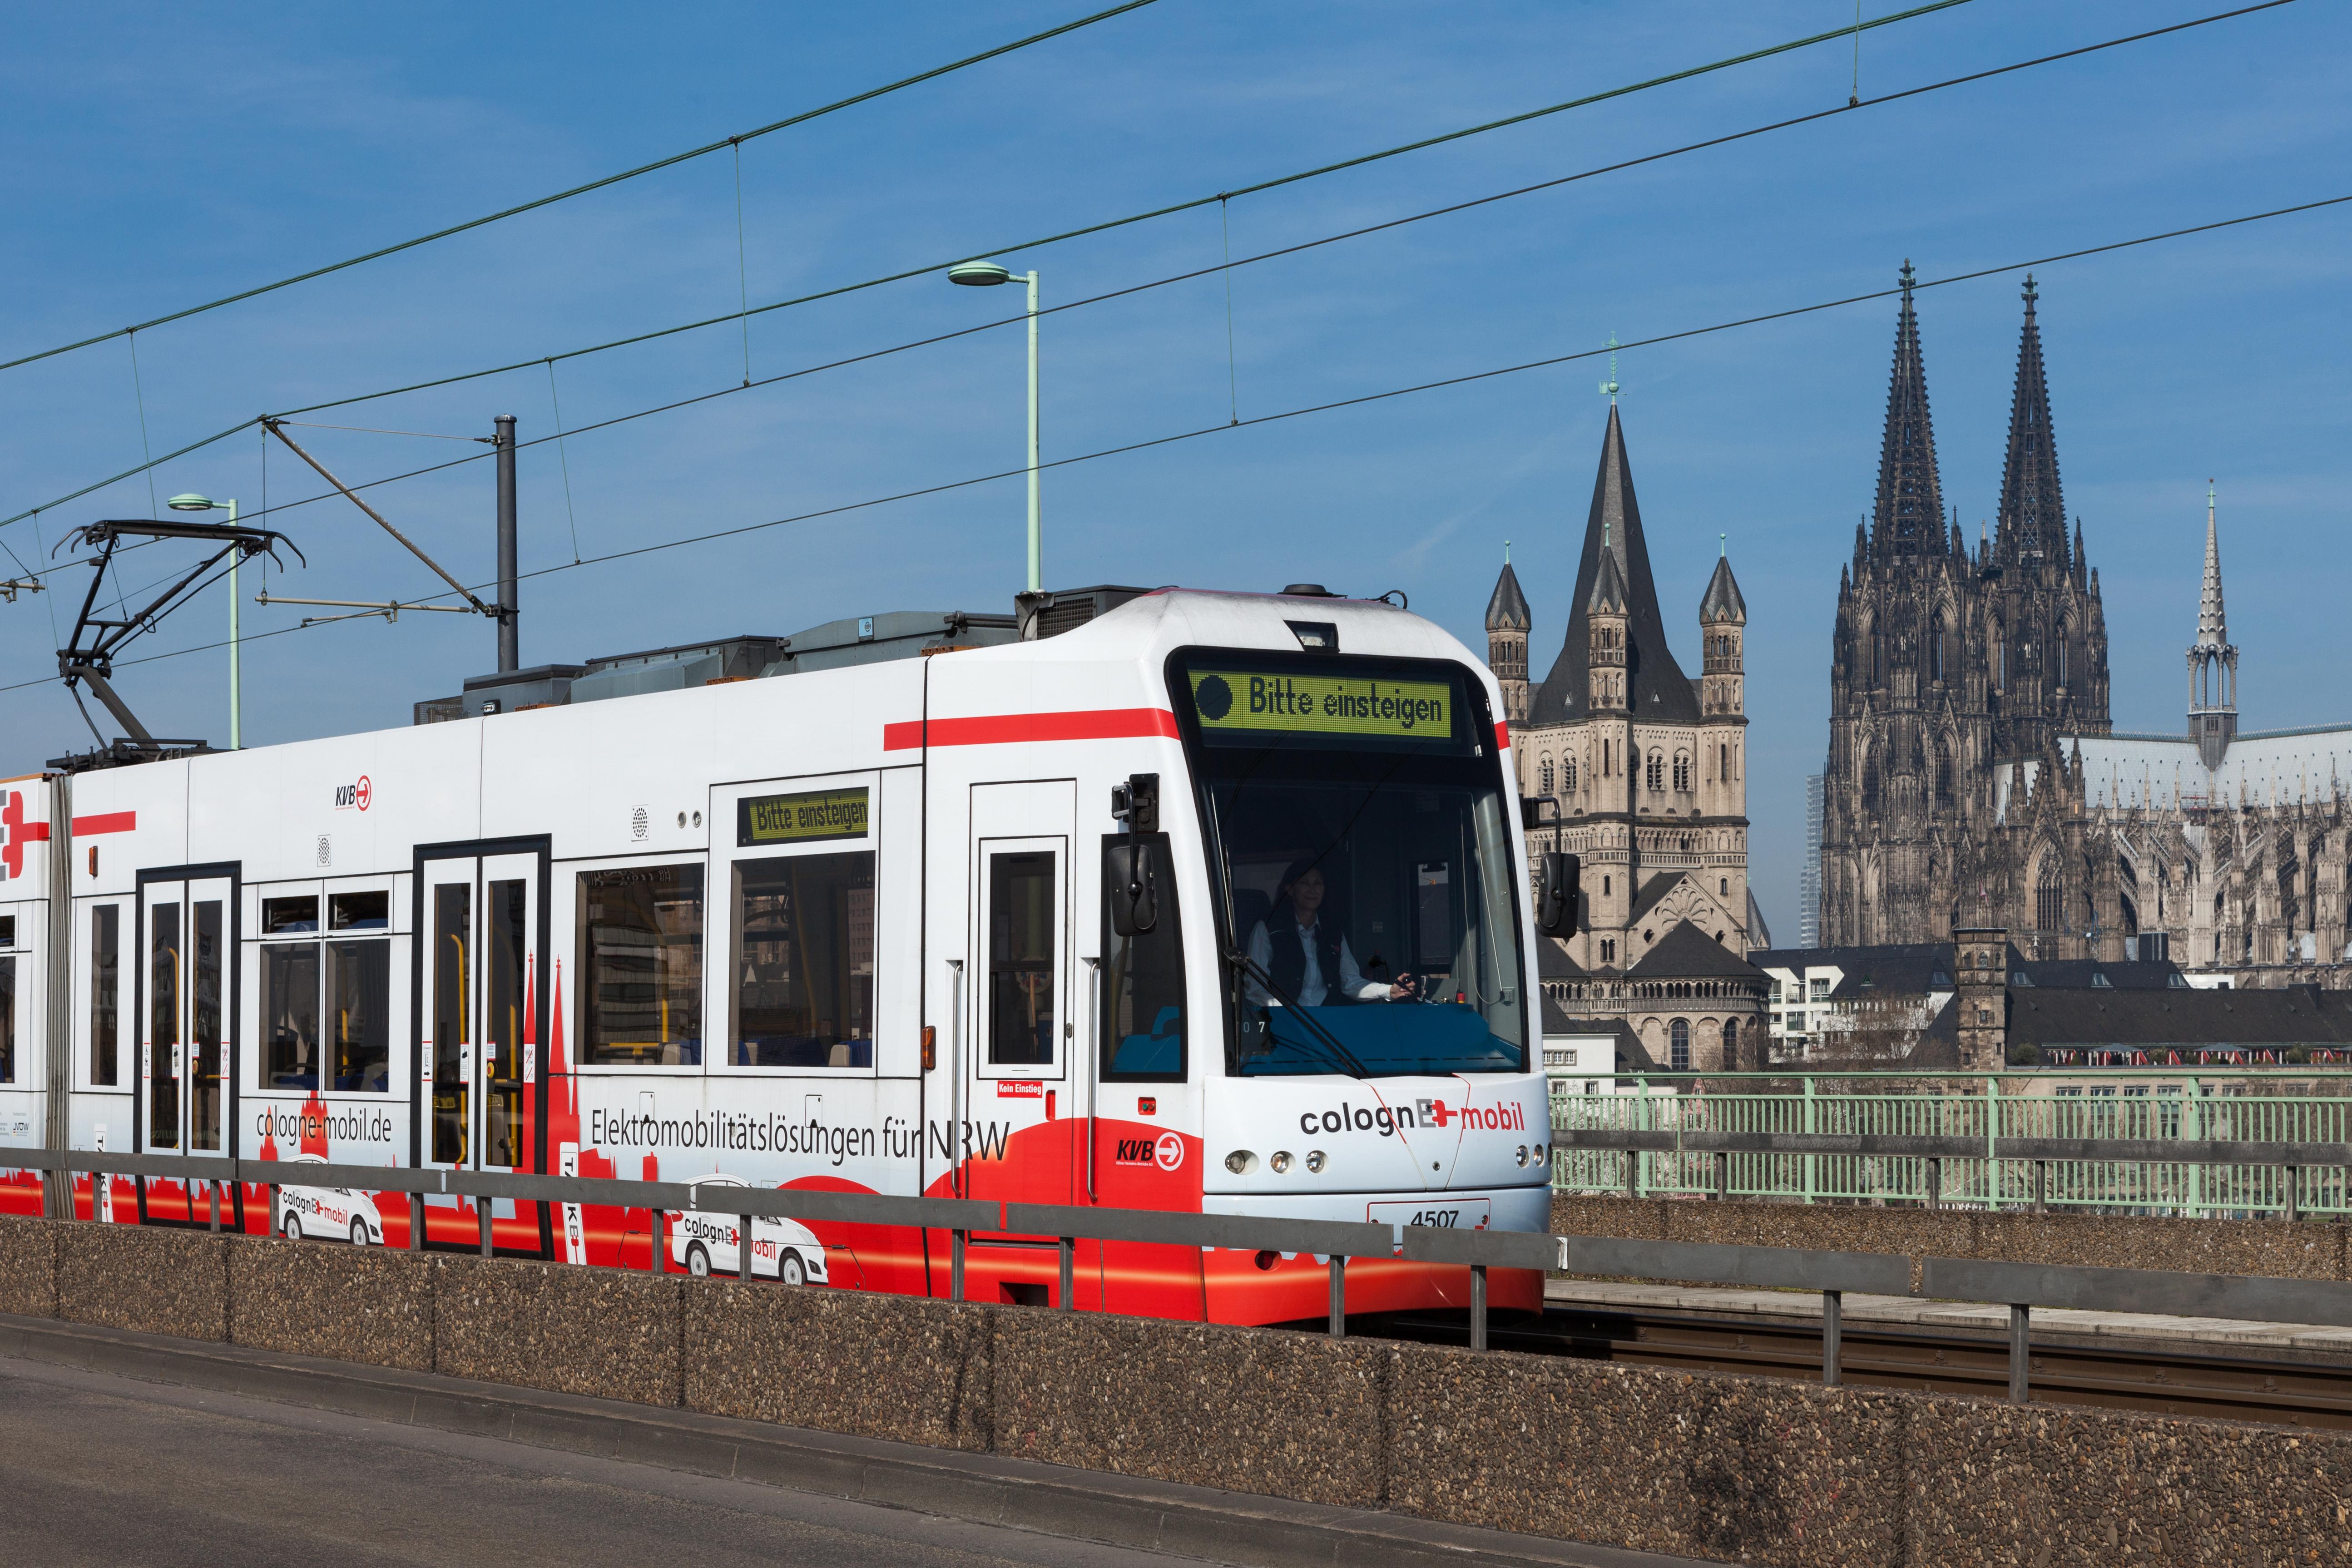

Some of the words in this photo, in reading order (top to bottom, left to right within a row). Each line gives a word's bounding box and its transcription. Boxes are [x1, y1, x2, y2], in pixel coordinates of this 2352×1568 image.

[1249, 677, 1312, 715] Bitte
[1323, 683, 1442, 729] einsteigen
[336, 785, 356, 806] KVB
[756, 800, 792, 831] Bitte
[797, 795, 868, 831] einsteigen
[999, 1083, 1013, 1093] Kein
[1015, 1083, 1041, 1095] Einstieg
[257, 1105, 391, 1146] cologne-mobil.de
[592, 1108, 875, 1166] Elektromobilitätslösungen
[882, 1116, 921, 1158] für
[930, 1120, 1010, 1161] NRW
[1117, 1139, 1154, 1161] KVB
[1411, 1210, 1459, 1228] 4507
